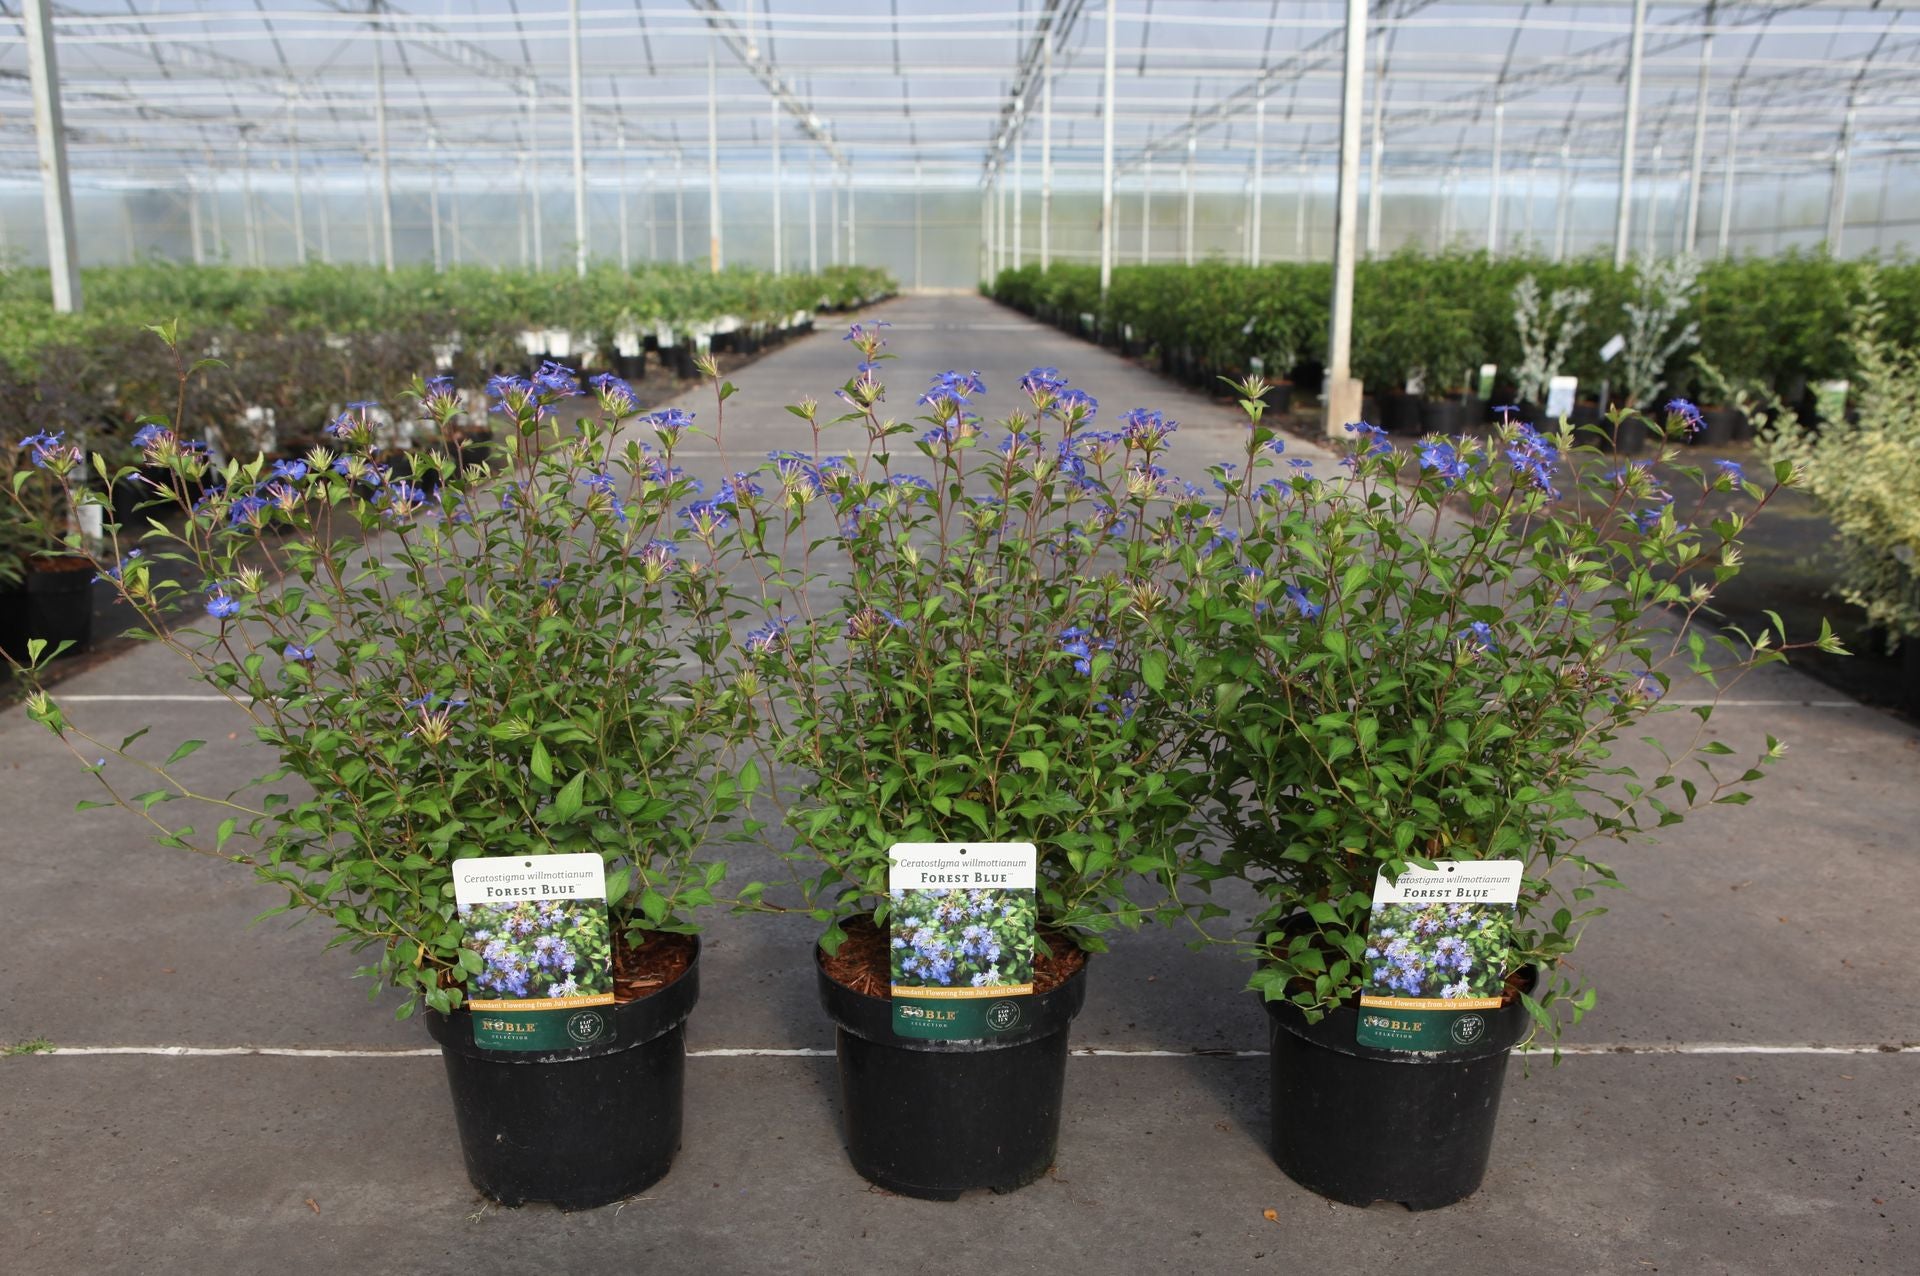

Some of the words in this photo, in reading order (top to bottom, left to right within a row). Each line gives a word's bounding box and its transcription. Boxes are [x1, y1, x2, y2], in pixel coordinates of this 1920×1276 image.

[900, 858, 960, 870] Ceratostigma
[962, 858, 1026, 868] willmottianum
[464, 874, 525, 884] Ceratostigma
[527, 870, 594, 880] willmottianum
[921, 872, 970, 883] FOREST
[974, 872, 1007, 883] BLUE
[1386, 876, 1444, 885] ratostigma
[1446, 875, 1510, 884] willmottianum
[487, 886, 536, 897] FOREST
[542, 884, 576, 895] BLUE
[1403, 888, 1452, 898] FOREST
[1456, 888, 1489, 898] BLUE
[926, 990, 957, 998] Flowering
[482, 1020, 536, 1032] NOBLE
[1367, 1016, 1422, 1032] NOBLE
